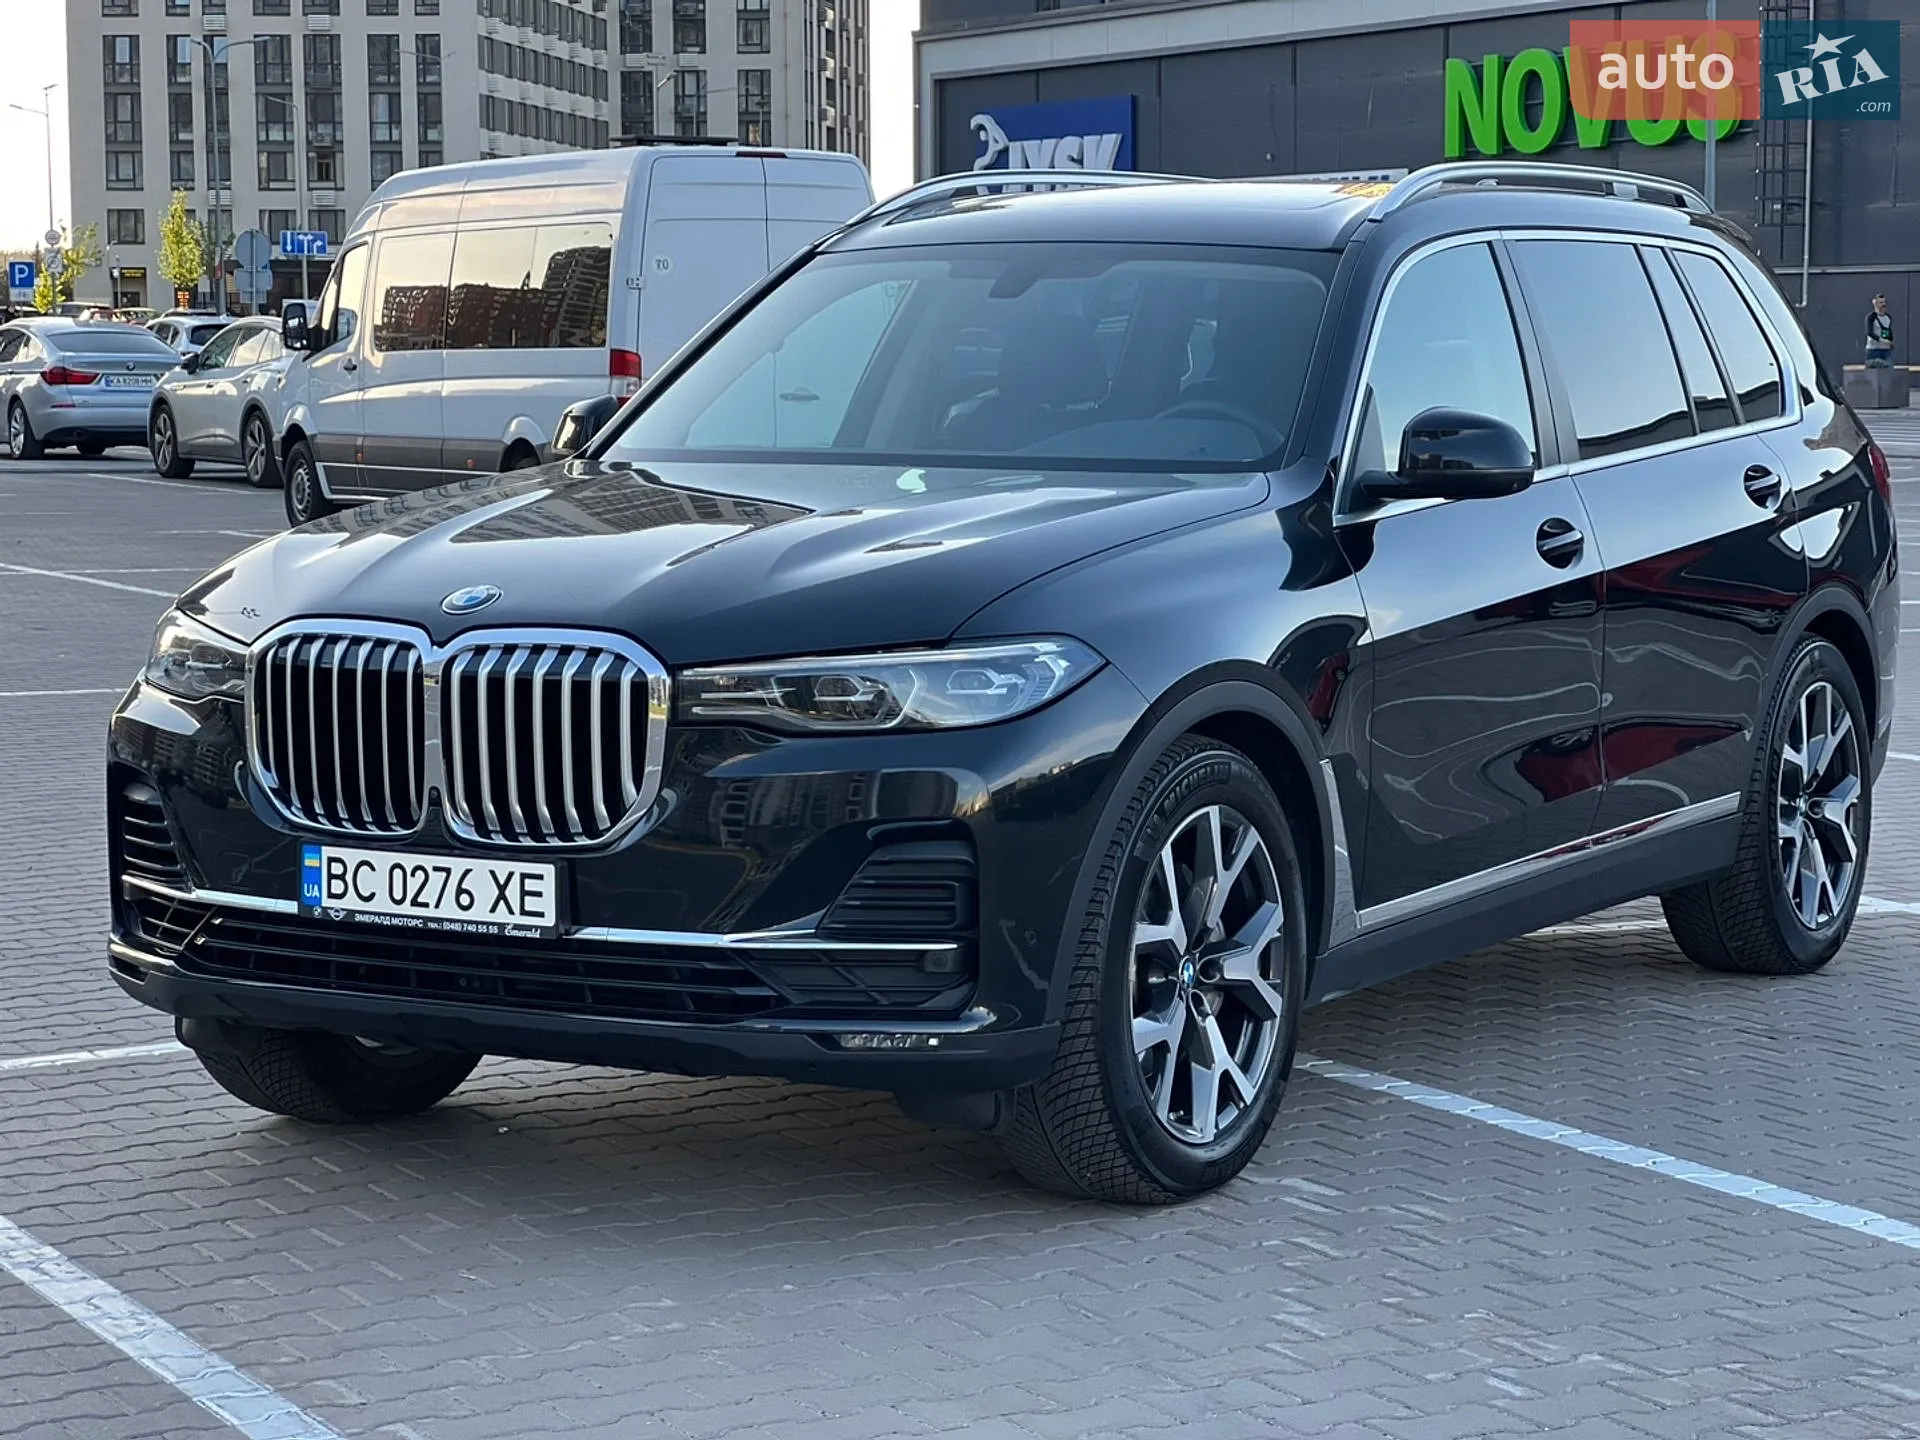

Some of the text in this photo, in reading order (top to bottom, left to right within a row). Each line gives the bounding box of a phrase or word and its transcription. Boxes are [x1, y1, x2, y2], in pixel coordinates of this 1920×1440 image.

[1444, 30, 1743, 159] NOVUS
[655, 258, 669, 271] 70
[304, 884, 320, 899] UA
[327, 856, 545, 918] BC 0276 XE
[391, 917, 423, 927] МОТОРС
[505, 924, 541, 938] Emerald
